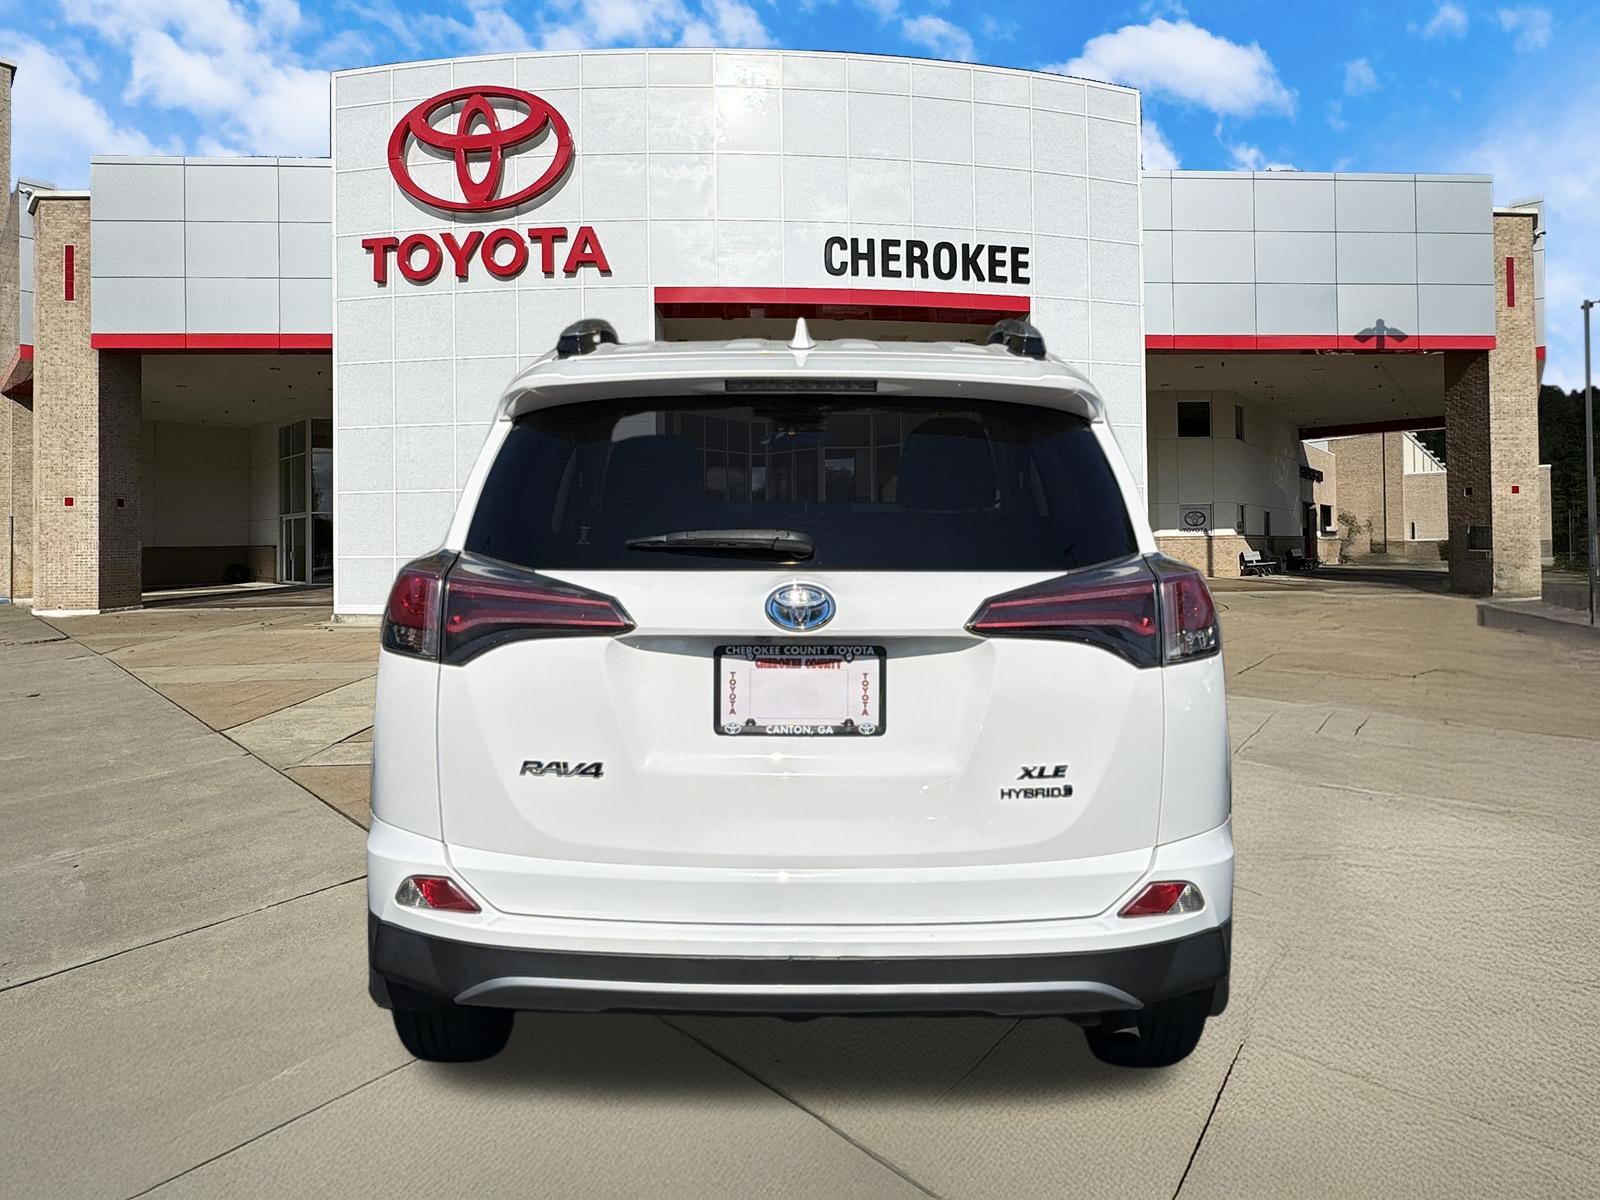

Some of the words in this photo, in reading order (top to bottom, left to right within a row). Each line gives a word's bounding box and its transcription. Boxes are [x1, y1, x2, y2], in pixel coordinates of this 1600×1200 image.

[362, 226, 612, 284] TOYOTA
[824, 236, 1031, 285] CHEROKEE
[725, 646, 780, 655] CHEROKEE
[783, 646, 829, 655] COUNTY
[833, 646, 875, 655] TOYOTA
[755, 658, 801, 669] CHEROKEE
[805, 658, 842, 669] COUNTY
[729, 672, 737, 715] TOYOTA
[766, 725, 814, 736] CANTON,
[818, 725, 834, 734] GA
[519, 760, 604, 779] RAV4
[1016, 764, 1068, 780] XLE
[1000, 787, 1061, 800] HYBRID
